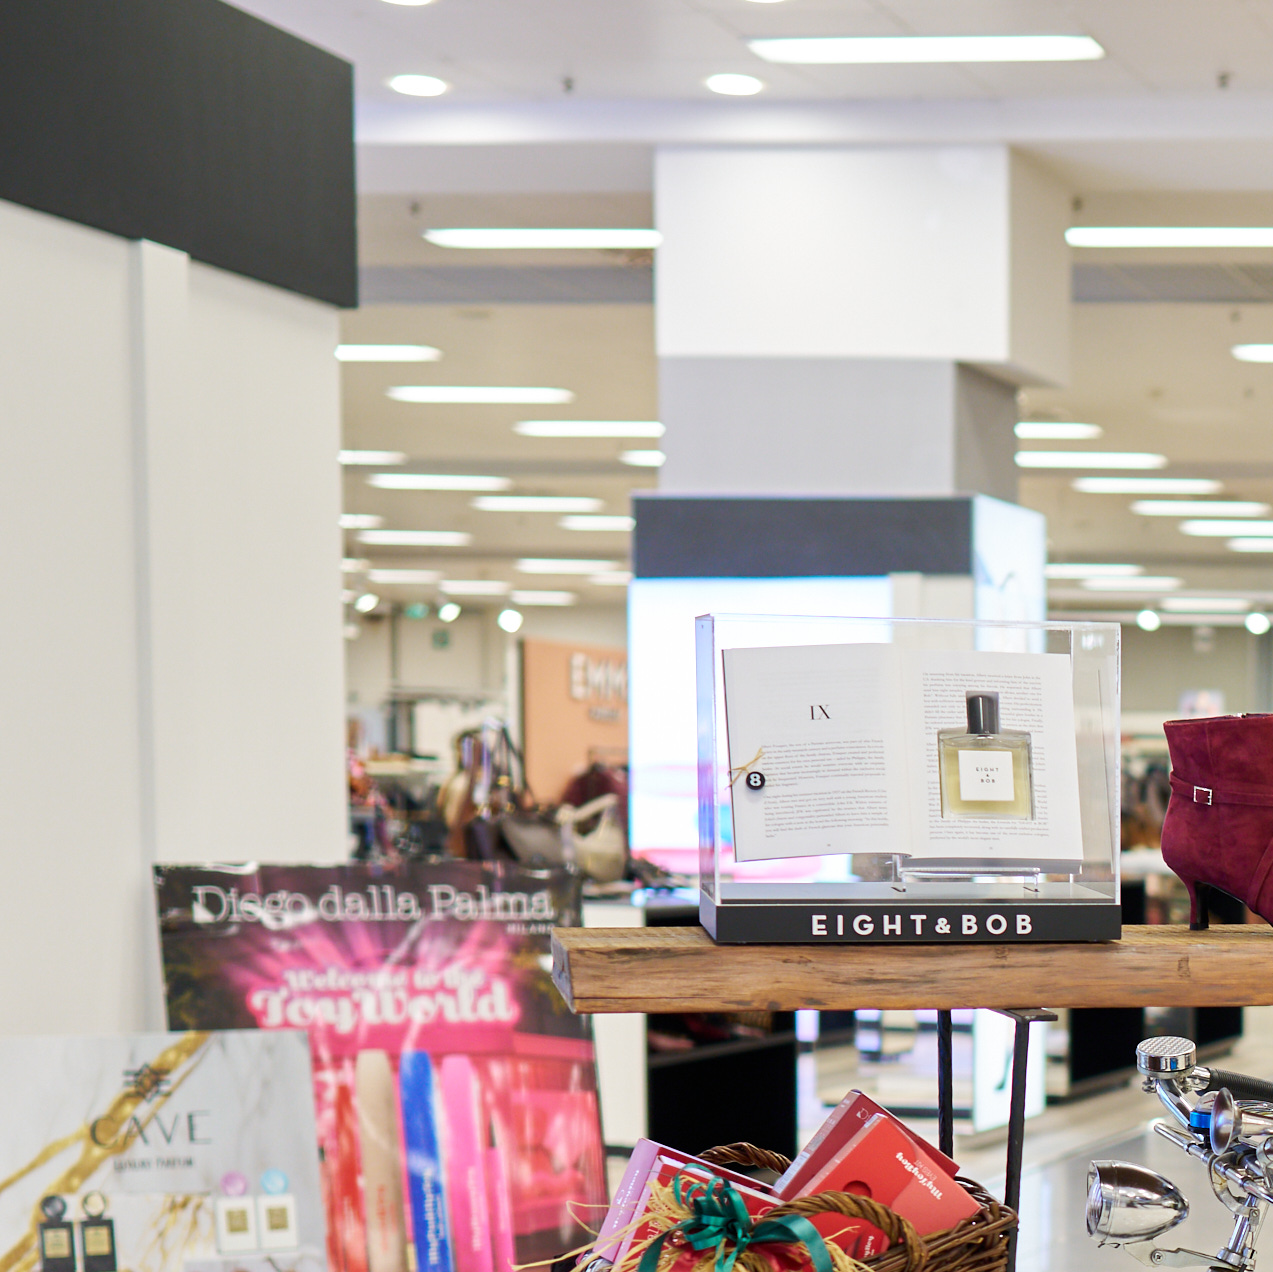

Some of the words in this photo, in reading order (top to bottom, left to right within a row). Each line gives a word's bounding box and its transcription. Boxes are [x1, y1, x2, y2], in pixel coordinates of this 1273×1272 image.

[809, 704, 831, 720] IX
[749, 773, 762, 787] 8
[191, 884, 316, 928] Diego
[319, 884, 422, 921] dalla
[427, 883, 555, 921] Palma
[283, 966, 406, 991] Welcome
[413, 967, 440, 990] to
[90, 1109, 212, 1149] CAVE
